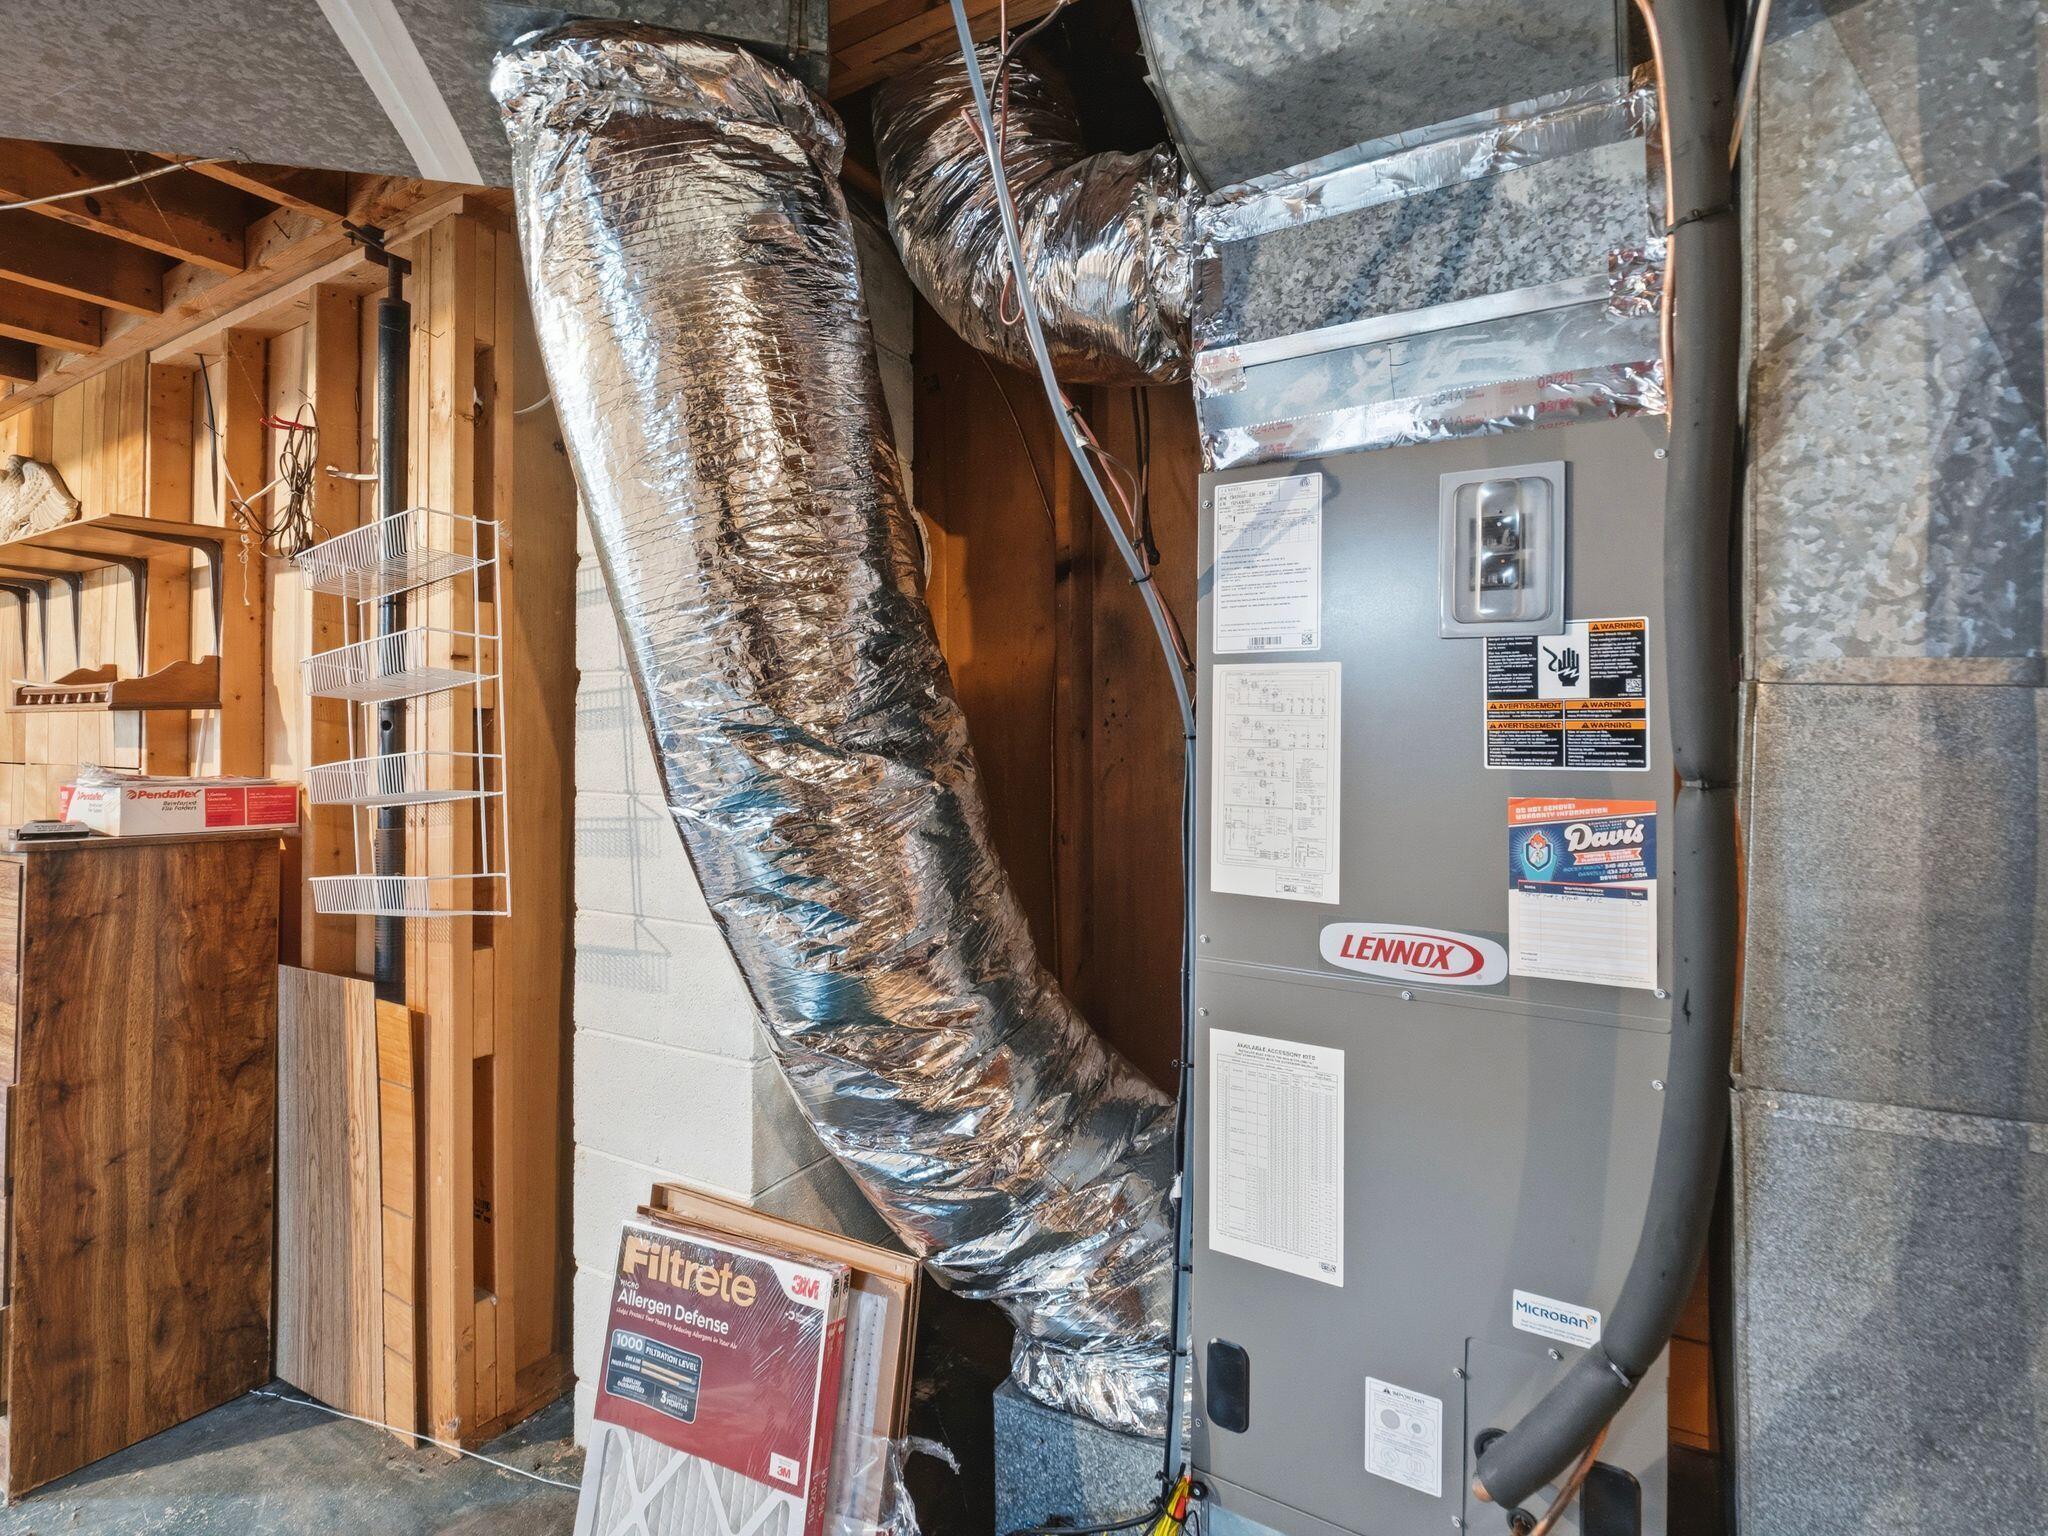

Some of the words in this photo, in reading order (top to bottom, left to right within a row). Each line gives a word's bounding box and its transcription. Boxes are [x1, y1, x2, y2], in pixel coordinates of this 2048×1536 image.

[1600, 622, 1643, 630] WARNING
[137, 788, 202, 800] Pendaflex
[1564, 820, 1645, 852] Davis
[1340, 934, 1455, 970] LENNOX
[623, 1235, 757, 1307] Filtrete
[791, 1274, 820, 1301] 3M
[617, 1289, 671, 1317] Allergen
[674, 1303, 729, 1335] Defense
[1516, 1300, 1589, 1330] MICROBAN
[667, 1321, 673, 1330] by
[673, 1324, 692, 1337] Reducing
[616, 1334, 643, 1352] 1000
[645, 1346, 679, 1366] FILTRATION
[678, 1357, 698, 1371] LEVEL
[660, 1390, 667, 1404] 3
[777, 1466, 791, 1479] 3M
